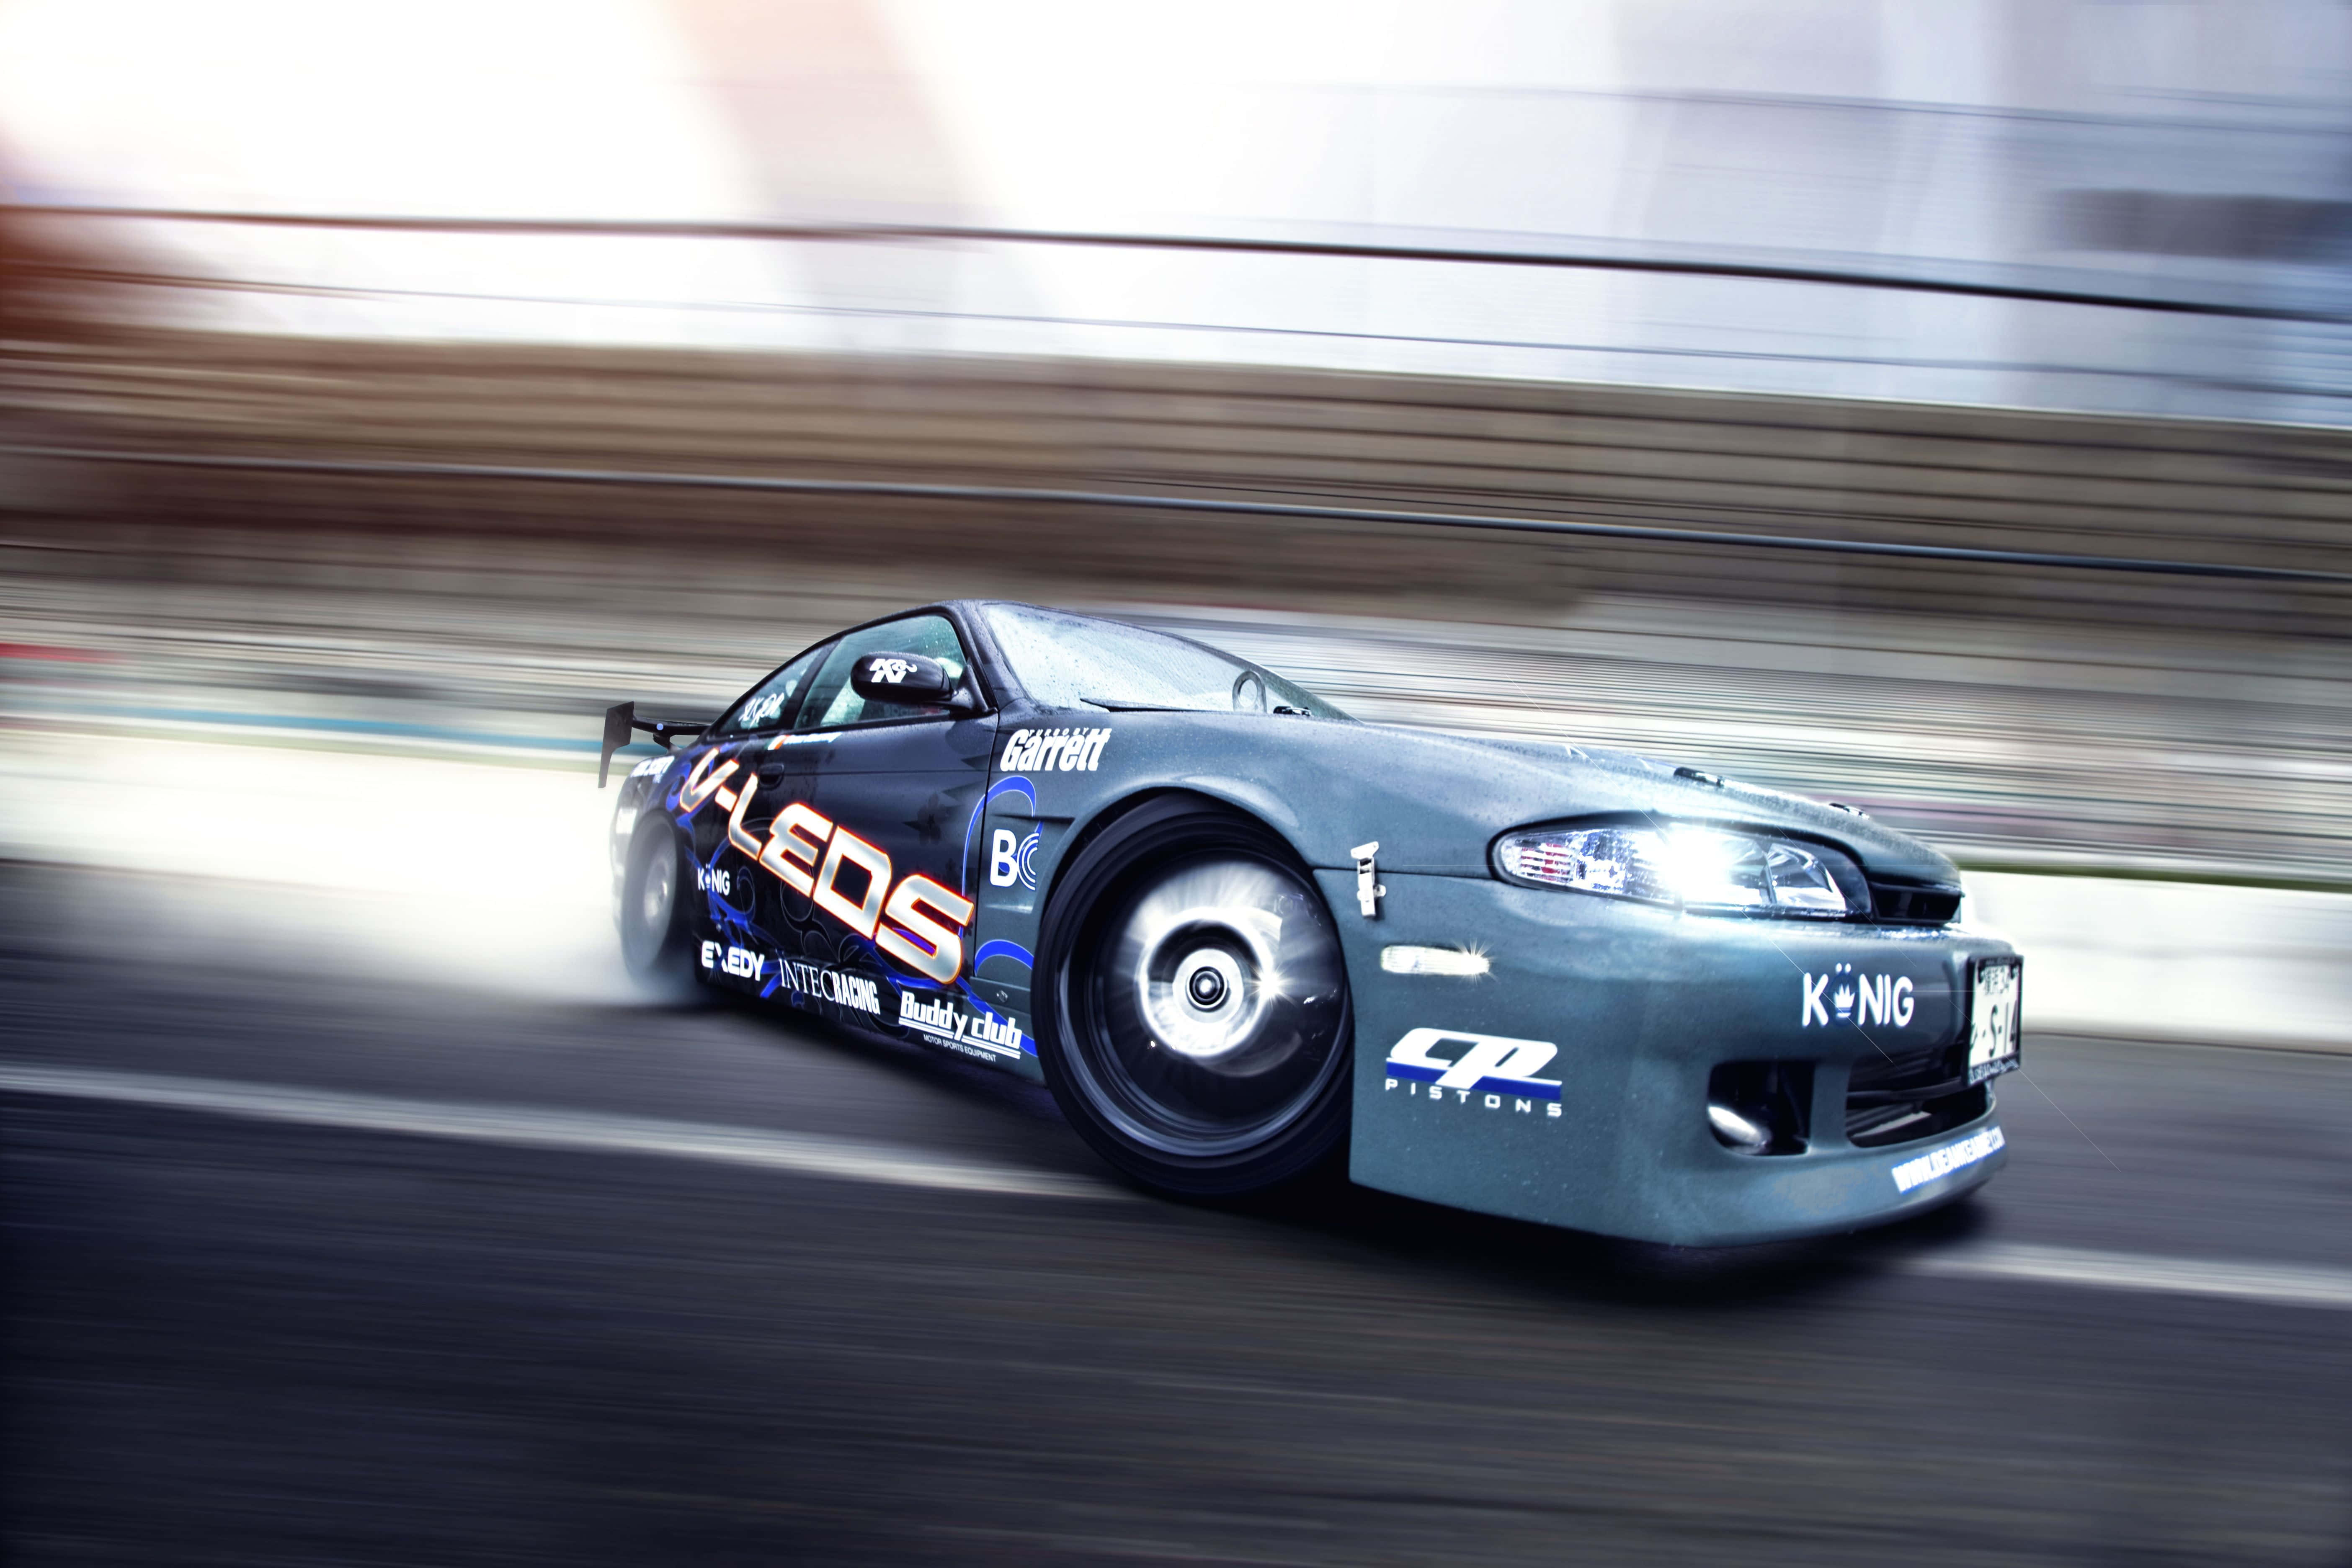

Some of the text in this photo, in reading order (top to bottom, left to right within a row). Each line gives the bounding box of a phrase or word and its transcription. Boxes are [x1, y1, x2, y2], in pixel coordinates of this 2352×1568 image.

[1000, 728, 1112, 771] Garrett
[1029, 727, 1089, 737] TURBO BY
[680, 748, 974, 985] V-LEDS
[701, 941, 765, 981] EXEDY
[900, 991, 1022, 1049] Buddy club
[923, 1034, 996, 1063] MOTOR SPORTS EQUIPMENT
[1390, 1027, 1558, 1089] CP
[1385, 1078, 1563, 1117] PISTONS
